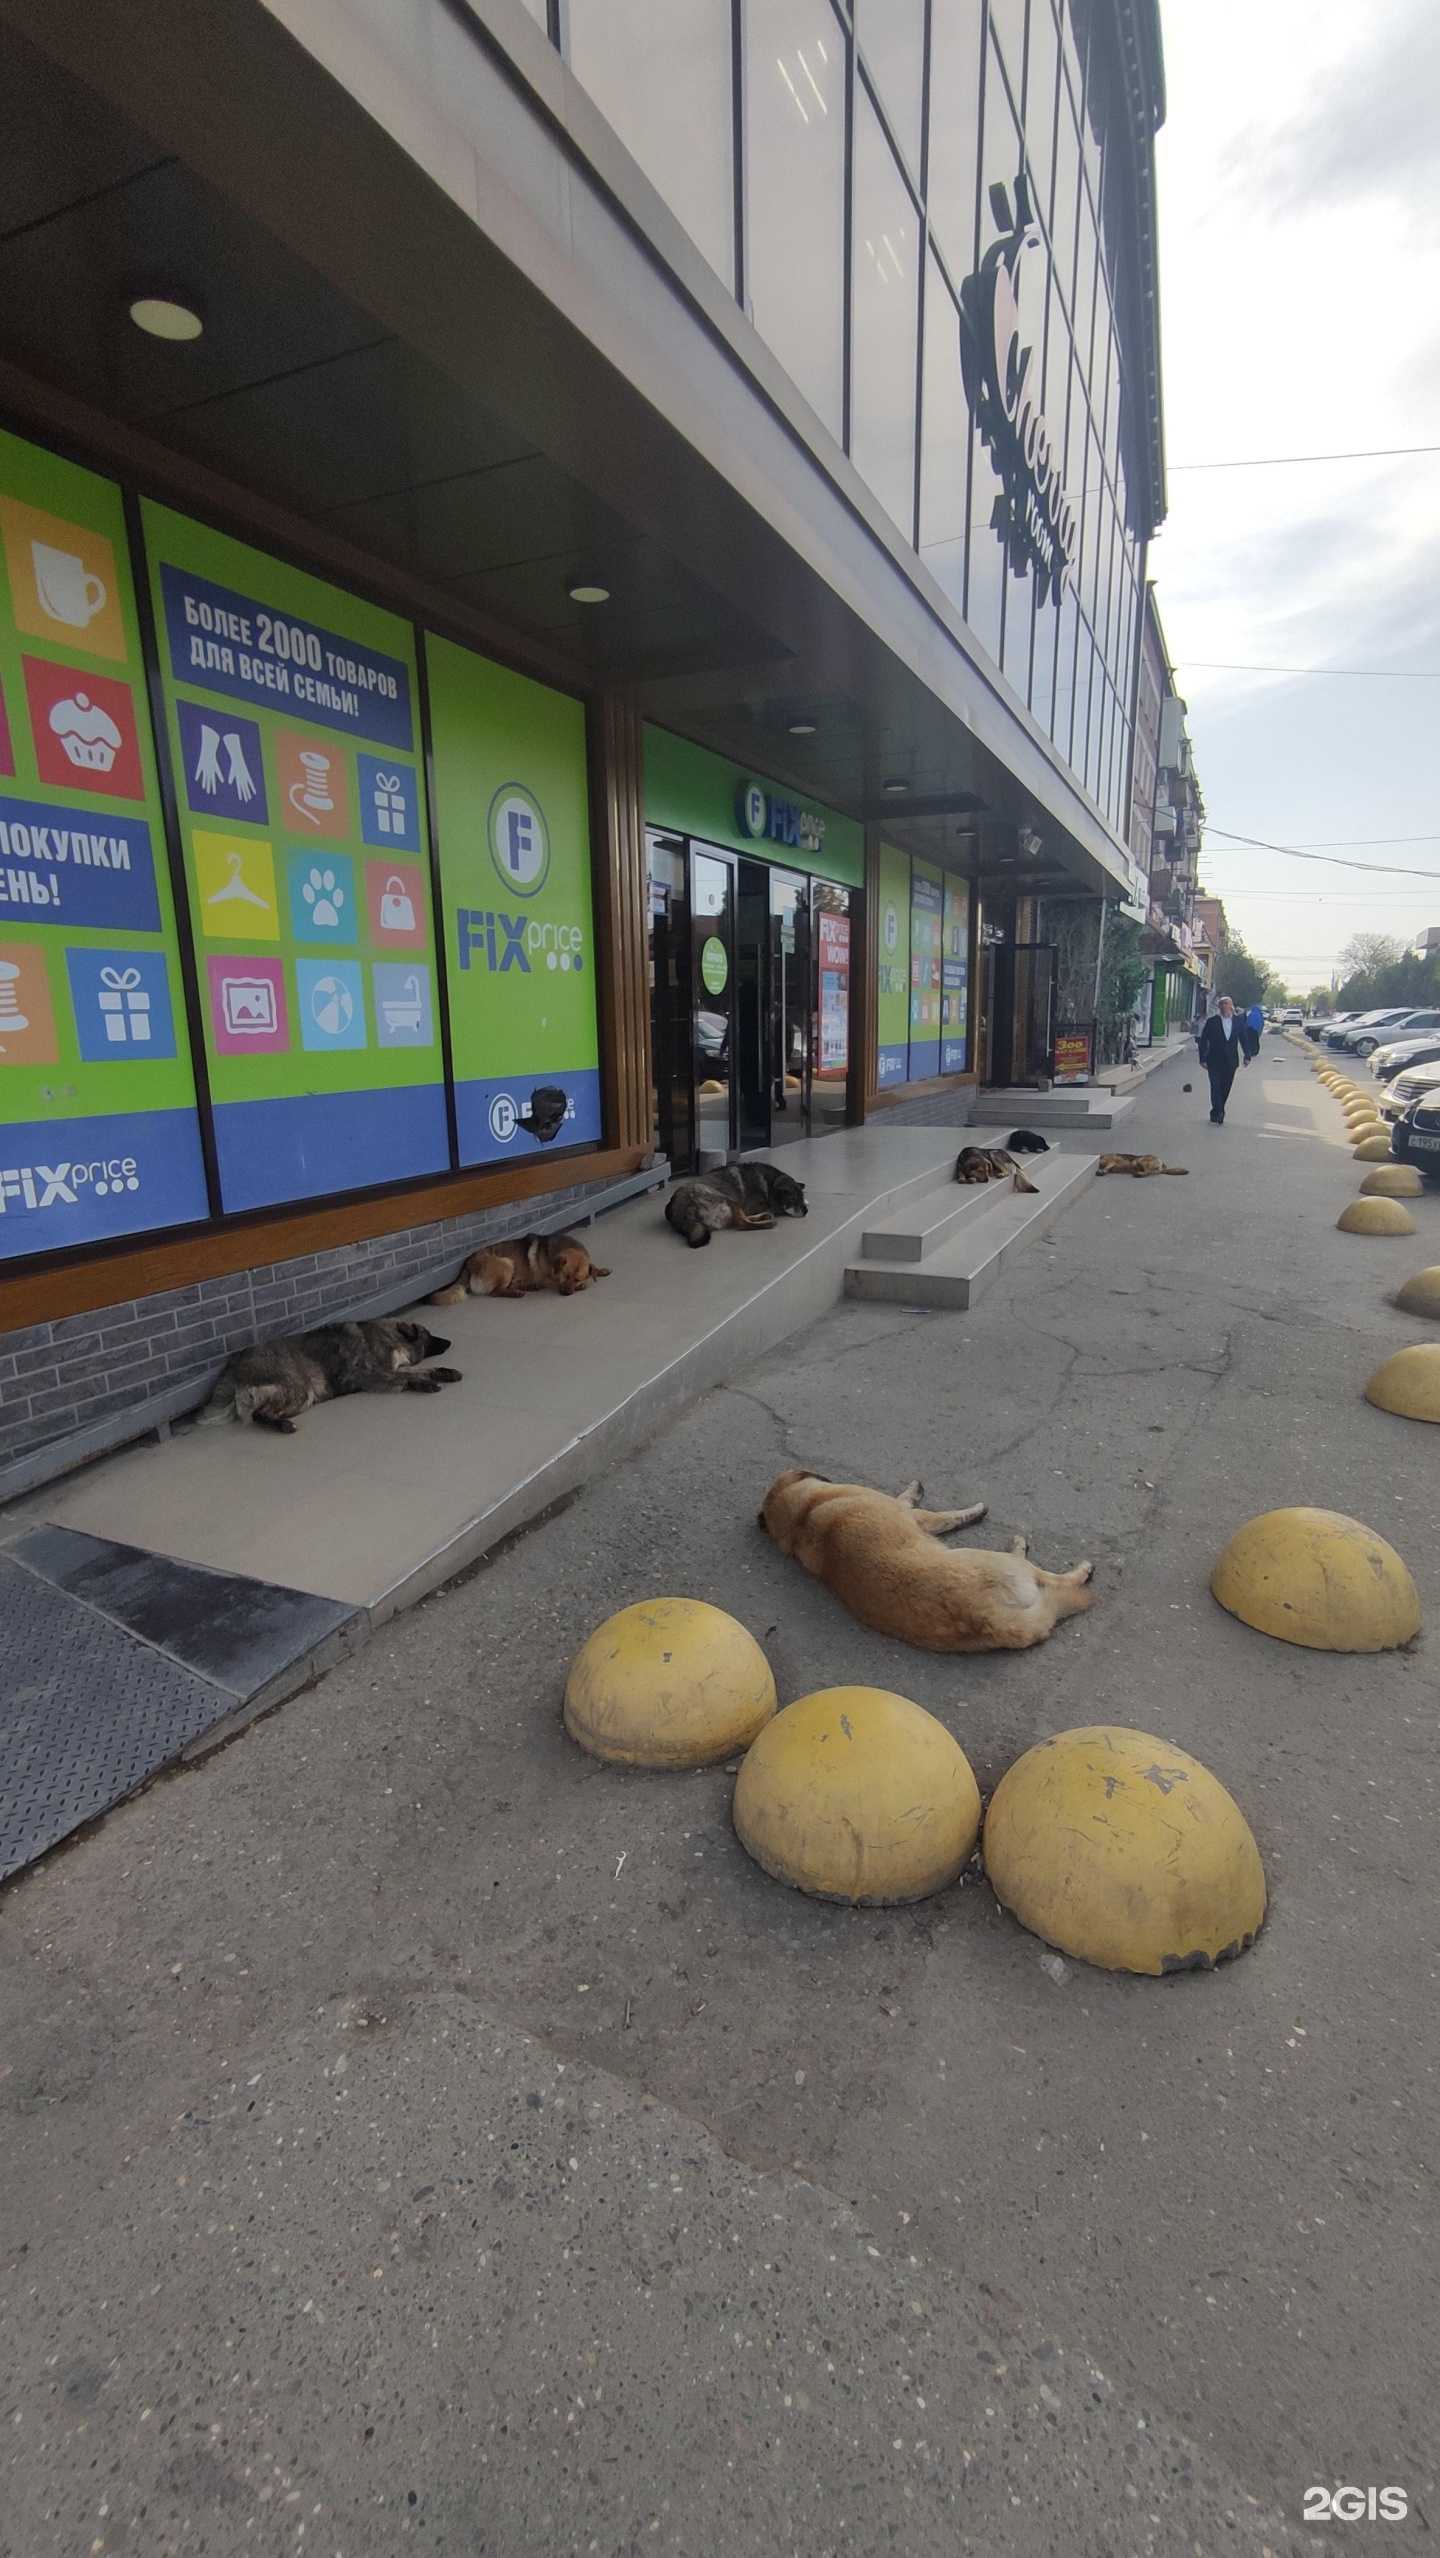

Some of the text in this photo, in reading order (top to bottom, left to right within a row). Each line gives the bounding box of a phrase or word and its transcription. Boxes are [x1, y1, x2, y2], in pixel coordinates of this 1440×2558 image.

[1025, 488, 1053, 573] room
[184, 596, 398, 700] БОЛЕЕ 2000 ТОВАРОВ
[190, 635, 359, 717] ДЛЯ ВСЕЙ СЕМЬИ!
[508, 811, 532, 871] F
[528, 921, 583, 955] price
[71, 1157, 137, 1190] price
